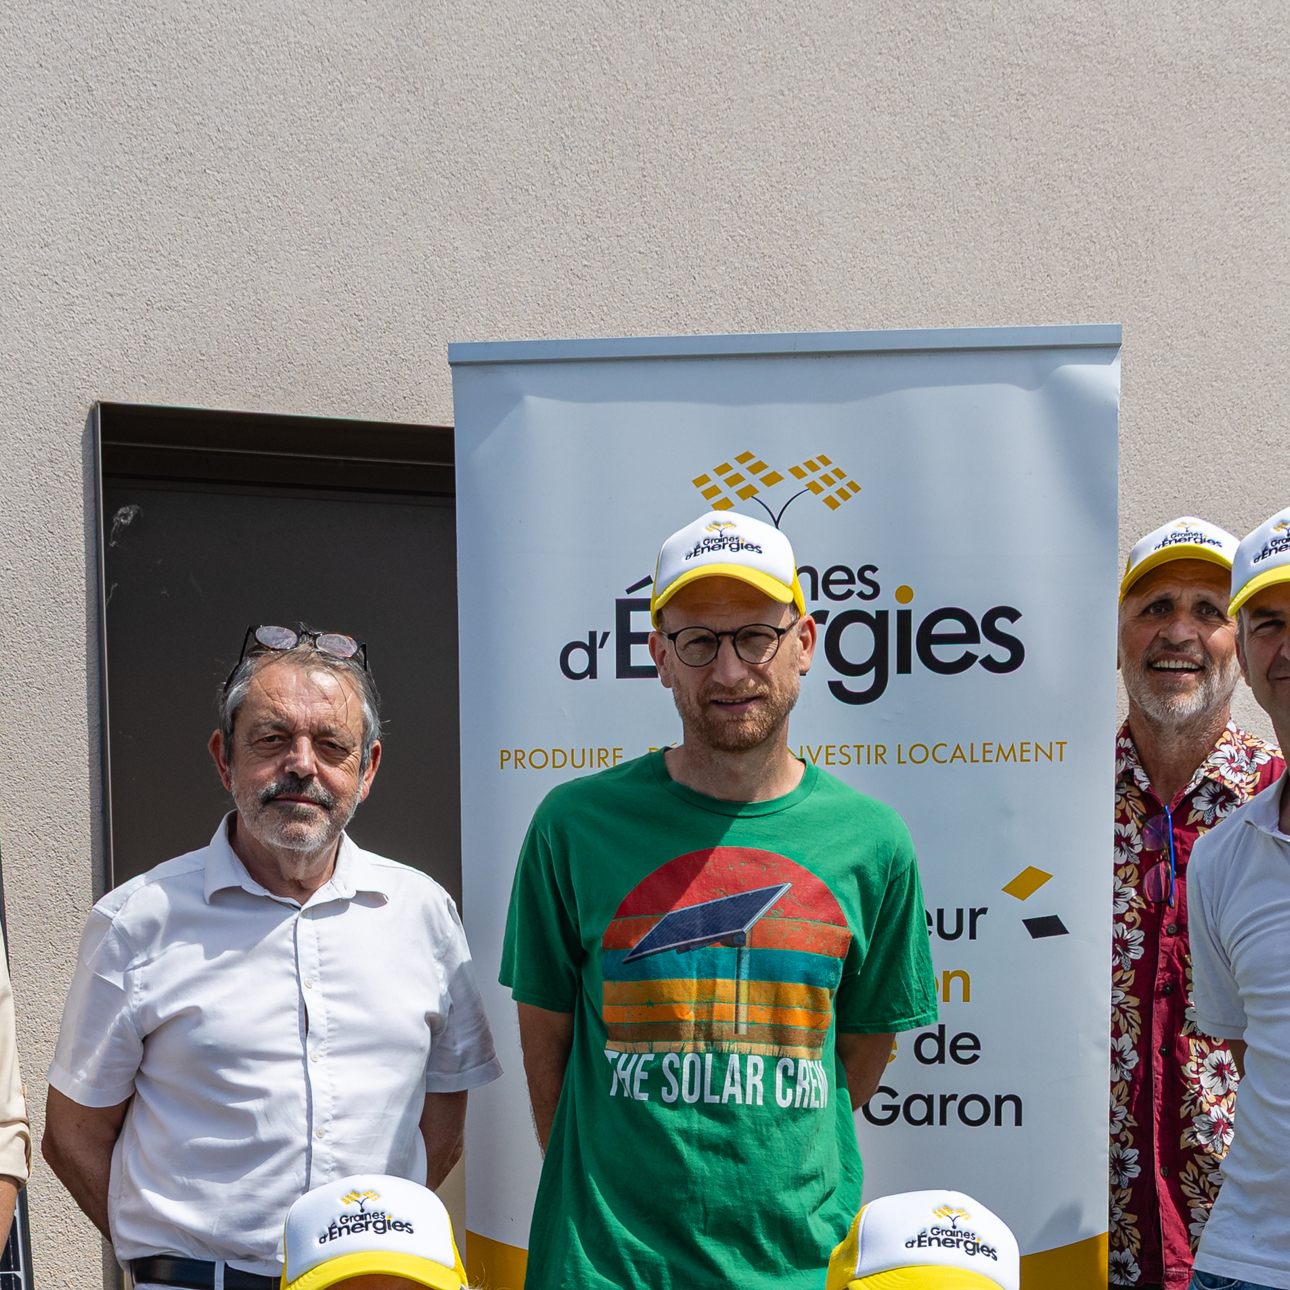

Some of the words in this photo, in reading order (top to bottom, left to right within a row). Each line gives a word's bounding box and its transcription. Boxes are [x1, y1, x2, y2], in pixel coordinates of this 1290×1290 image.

[703, 536, 740, 546] Graines
[897, 741, 1068, 765] LOCALEMENT
[913, 1023, 982, 1066] de
[603, 1050, 656, 1101] THE
[661, 1053, 765, 1106] SOLAR
[775, 1057, 829, 1109] CREW
[340, 1211, 386, 1225] Graines
[930, 1227, 975, 1240] Graines
